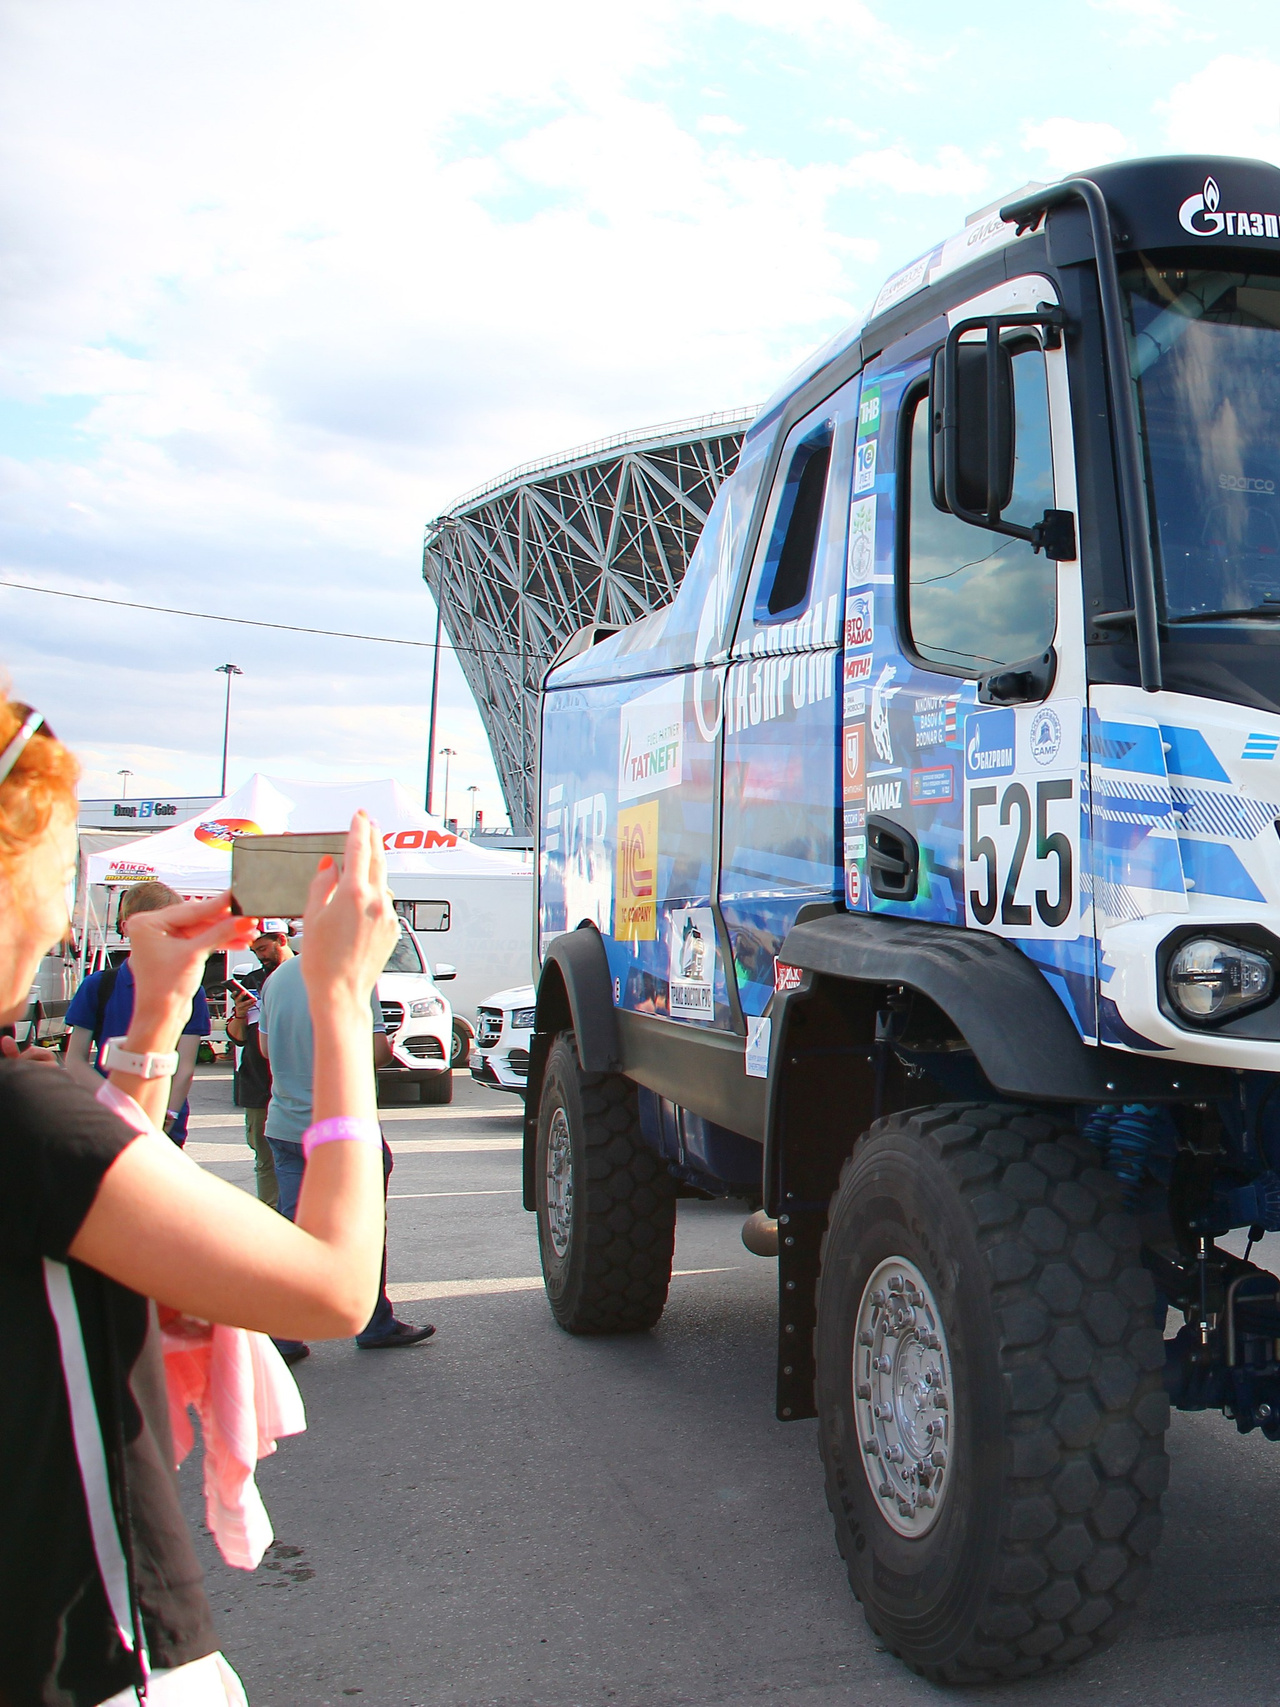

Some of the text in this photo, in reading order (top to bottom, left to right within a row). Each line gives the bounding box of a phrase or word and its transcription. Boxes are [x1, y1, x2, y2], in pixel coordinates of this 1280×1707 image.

[1218, 473, 1275, 492] sparco
[846, 627, 873, 645] РАДИО
[631, 741, 680, 783] TATNEFT
[979, 748, 1013, 771] GAZPROM
[867, 781, 902, 813] KAMAZ
[969, 778, 1073, 928] 525
